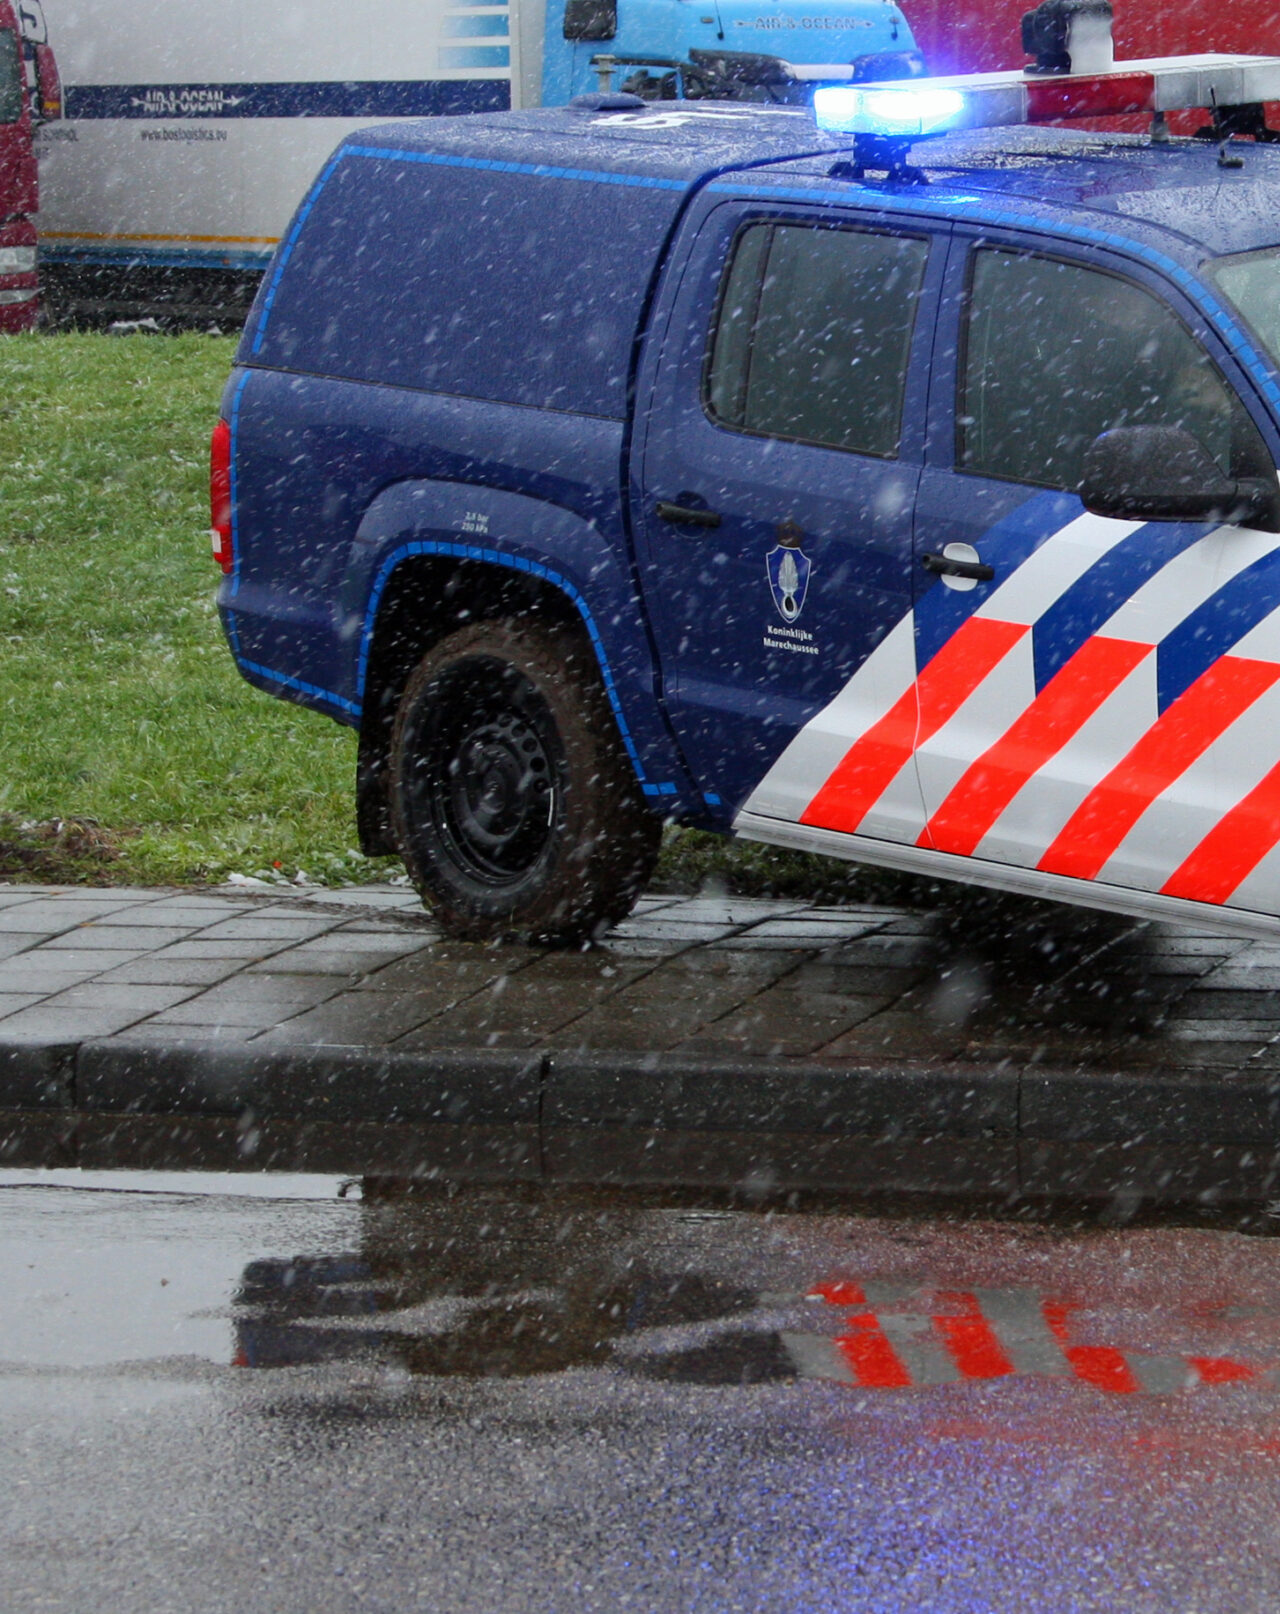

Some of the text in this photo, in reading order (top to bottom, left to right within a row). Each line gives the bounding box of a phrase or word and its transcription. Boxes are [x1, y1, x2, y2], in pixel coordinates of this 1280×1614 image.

[800, 17, 856, 30] OCEAN
[180, 90, 223, 112] OCEAN
[767, 625, 813, 641] Koninklijke
[763, 637, 820, 655] Marechaussee
